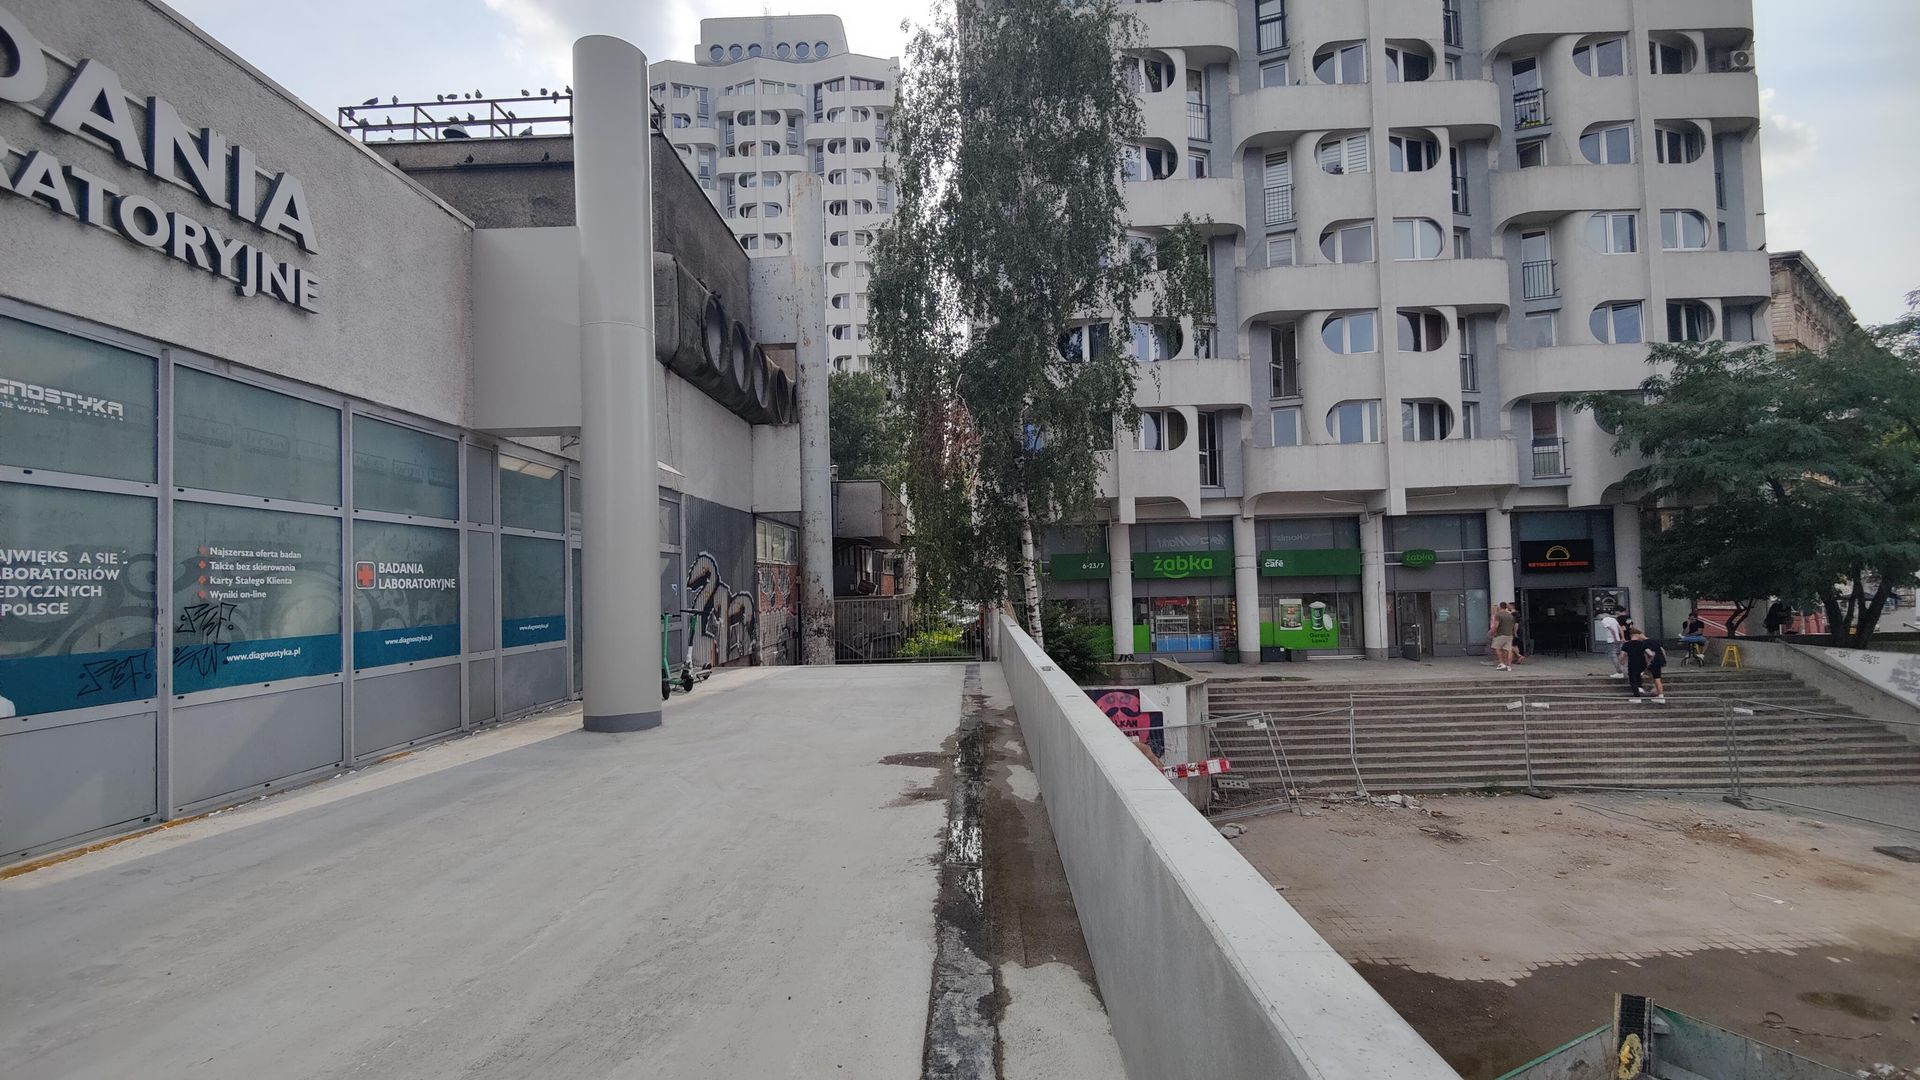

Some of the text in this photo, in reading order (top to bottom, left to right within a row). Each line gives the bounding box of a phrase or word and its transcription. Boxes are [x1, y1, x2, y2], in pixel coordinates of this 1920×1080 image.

[209, 547, 254, 558] Najszersza
[255, 550, 278, 558] oferta
[209, 561, 296, 572] Także bez skierowania
[378, 562, 424, 574] BADANIA
[1152, 555, 1213, 573] żabka
[1264, 558, 1284, 568] café
[0, 566, 120, 581] BORATORIÓW
[209, 576, 233, 587] Karty
[266, 576, 293, 585] Klienta
[378, 578, 456, 591] LABORATORYJNE
[209, 590, 267, 601] Wyniki on-line
[1, 602, 69, 617] POLSCE
[384, 634, 433, 645] www.diagnostyka.pl
[226, 647, 301, 662] www.diagnostyka.pl
